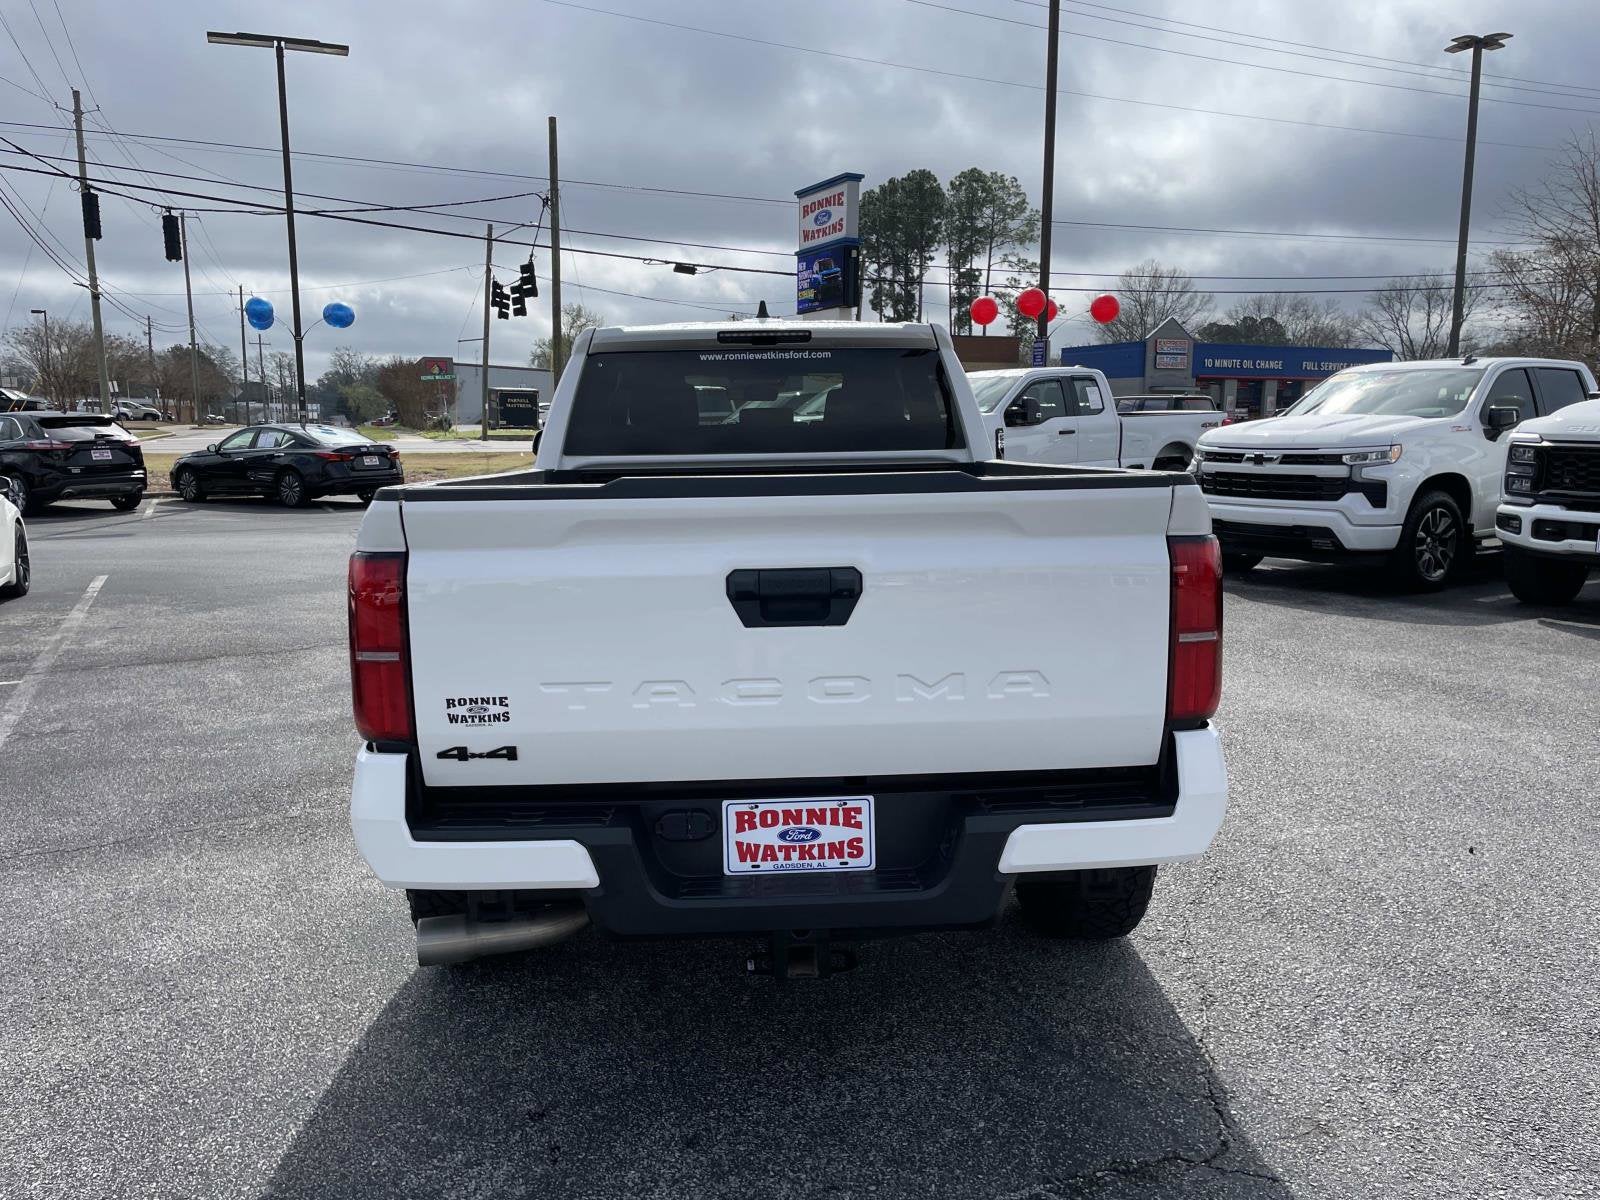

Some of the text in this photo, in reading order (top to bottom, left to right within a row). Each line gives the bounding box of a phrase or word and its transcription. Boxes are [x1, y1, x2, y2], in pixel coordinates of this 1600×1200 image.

[802, 191, 845, 219] RONNIE
[802, 217, 844, 243] WATKINS
[699, 350, 832, 361] www.ronniewatkinsford.com
[1204, 358, 1284, 370] 10 MINUTE OIL CHANGE
[1302, 361, 1319, 370] FULL
[540, 670, 1050, 710] TACOMA
[446, 697, 509, 709] RONNIE
[447, 711, 511, 724] WATKINS
[735, 806, 863, 834] RONNIE
[785, 829, 812, 841] Ford
[735, 837, 864, 863] WATKINS
